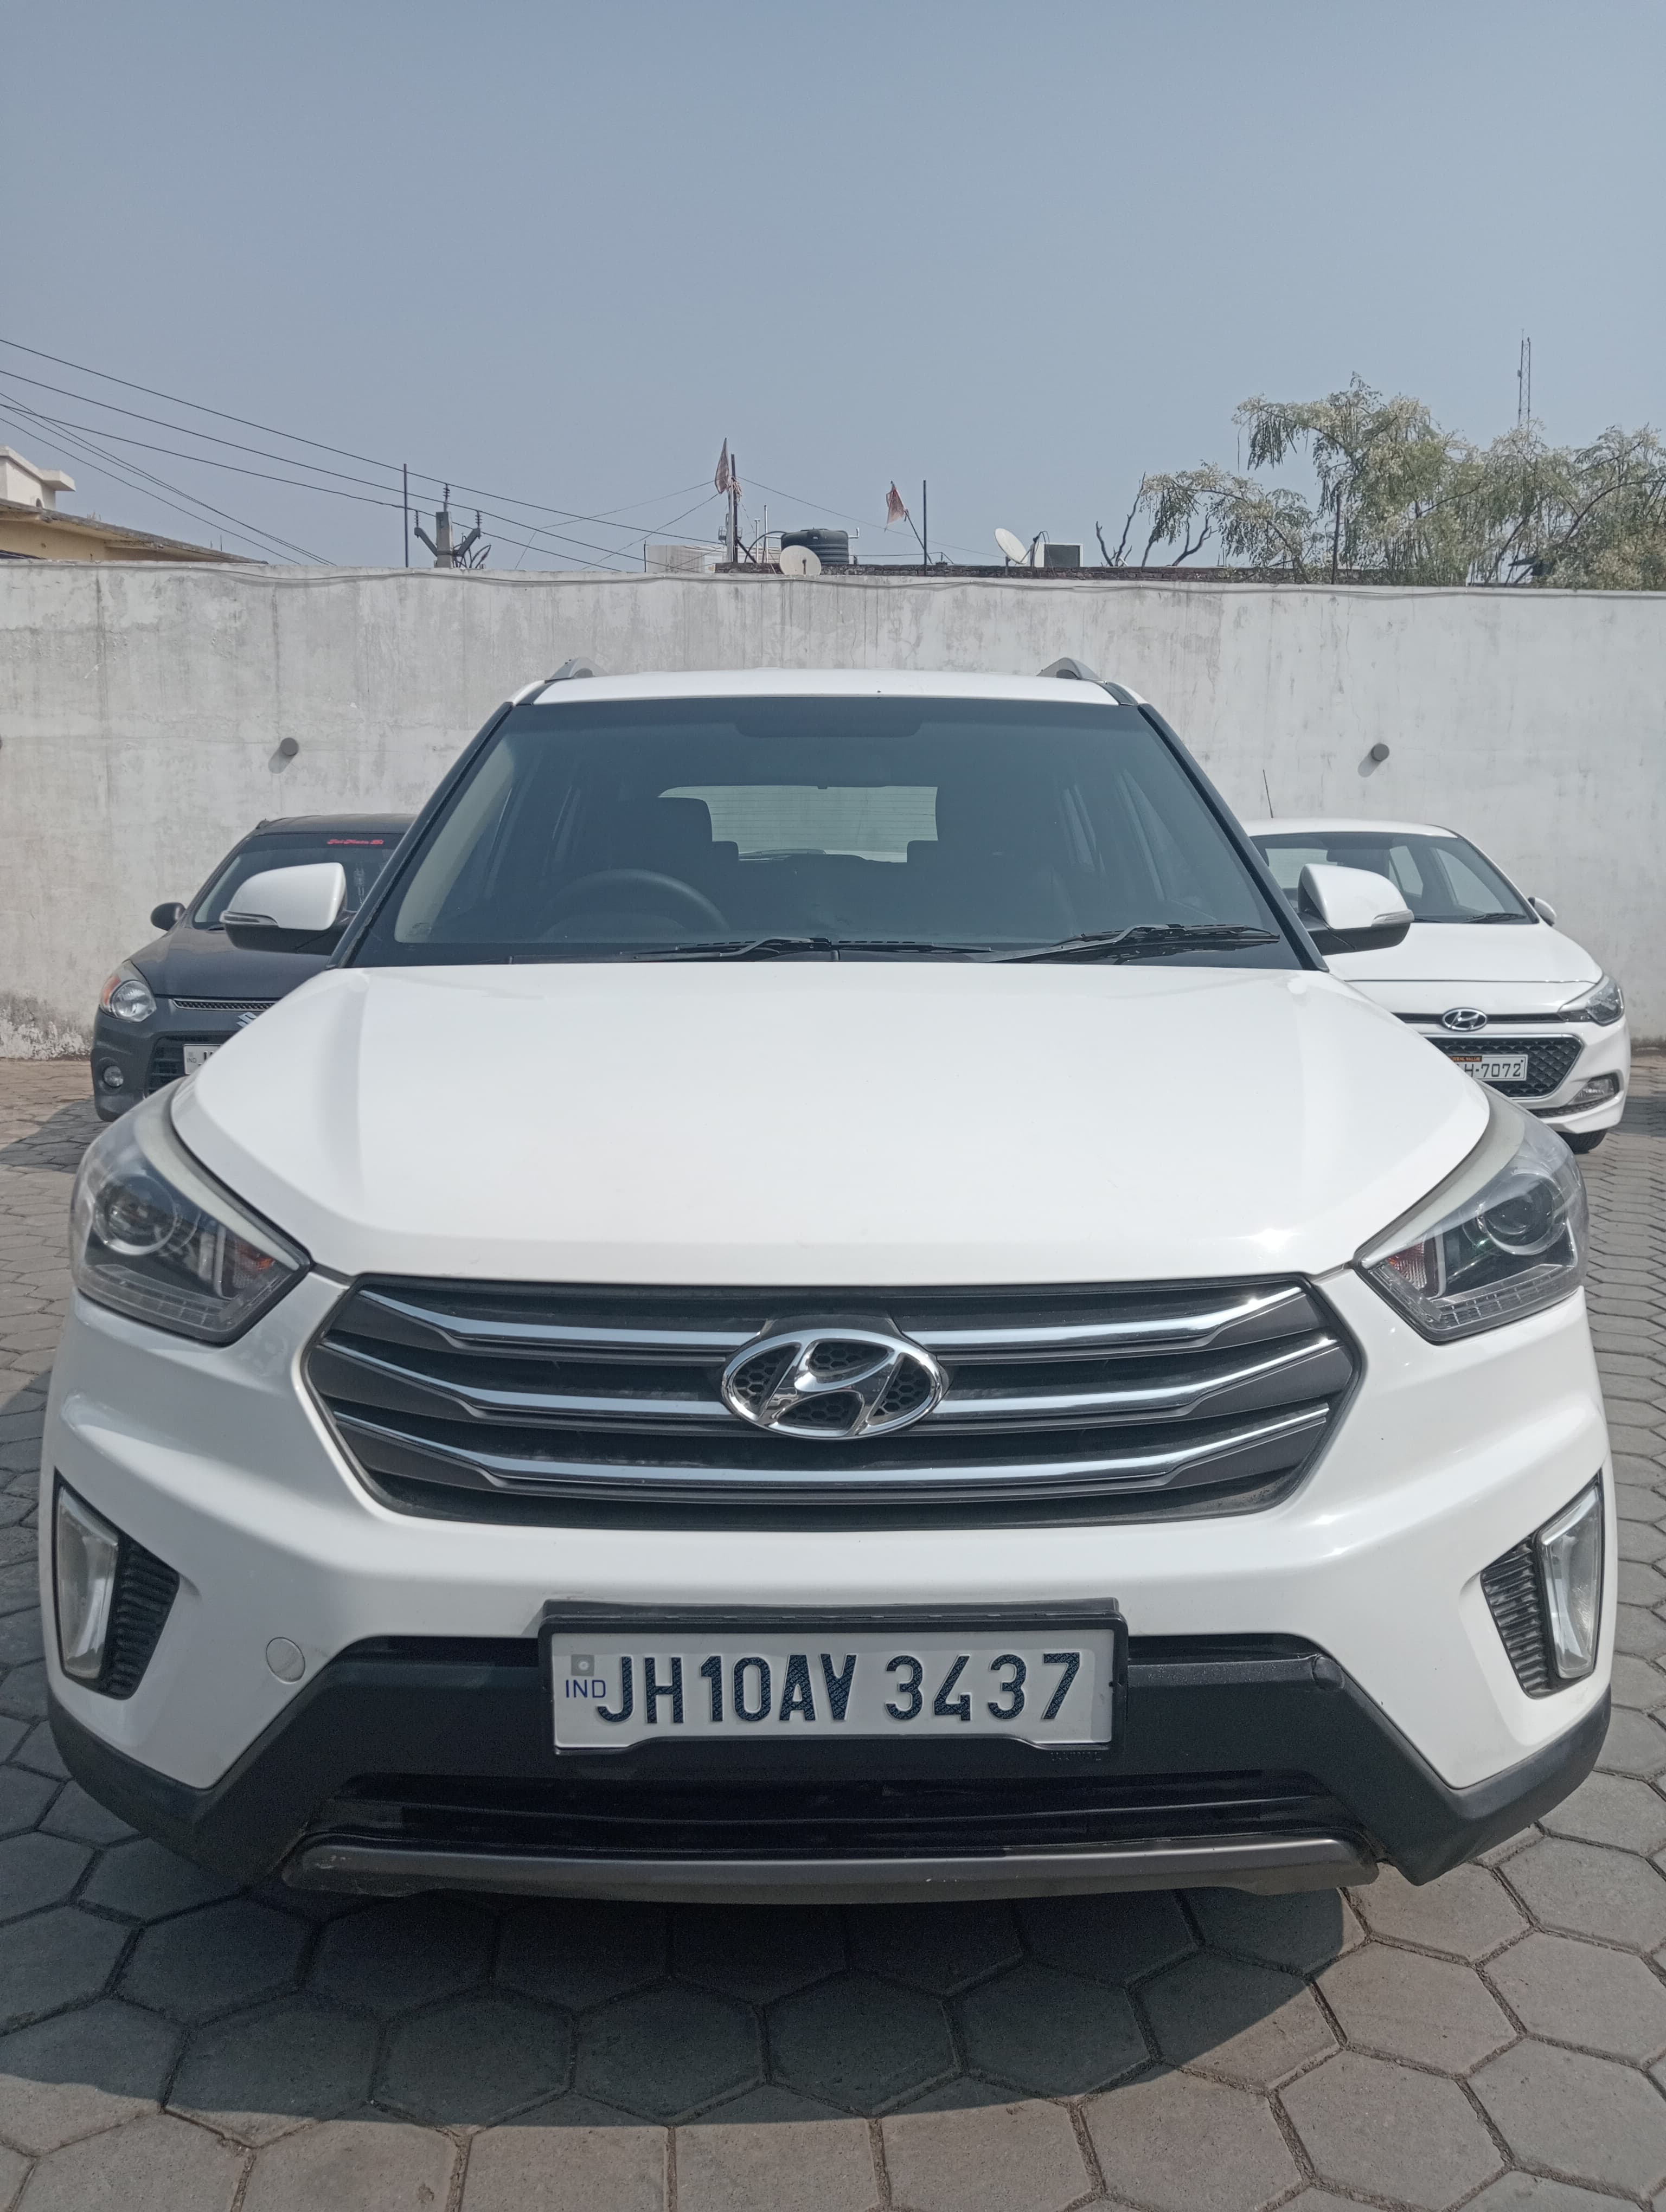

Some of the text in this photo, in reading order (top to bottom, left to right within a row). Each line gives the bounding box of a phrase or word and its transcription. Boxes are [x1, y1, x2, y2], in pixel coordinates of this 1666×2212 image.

[1457, 1063, 1521, 1078] H-7072
[566, 1679, 606, 1699] IND
[596, 1652, 1081, 1724] JH10AV 3437
